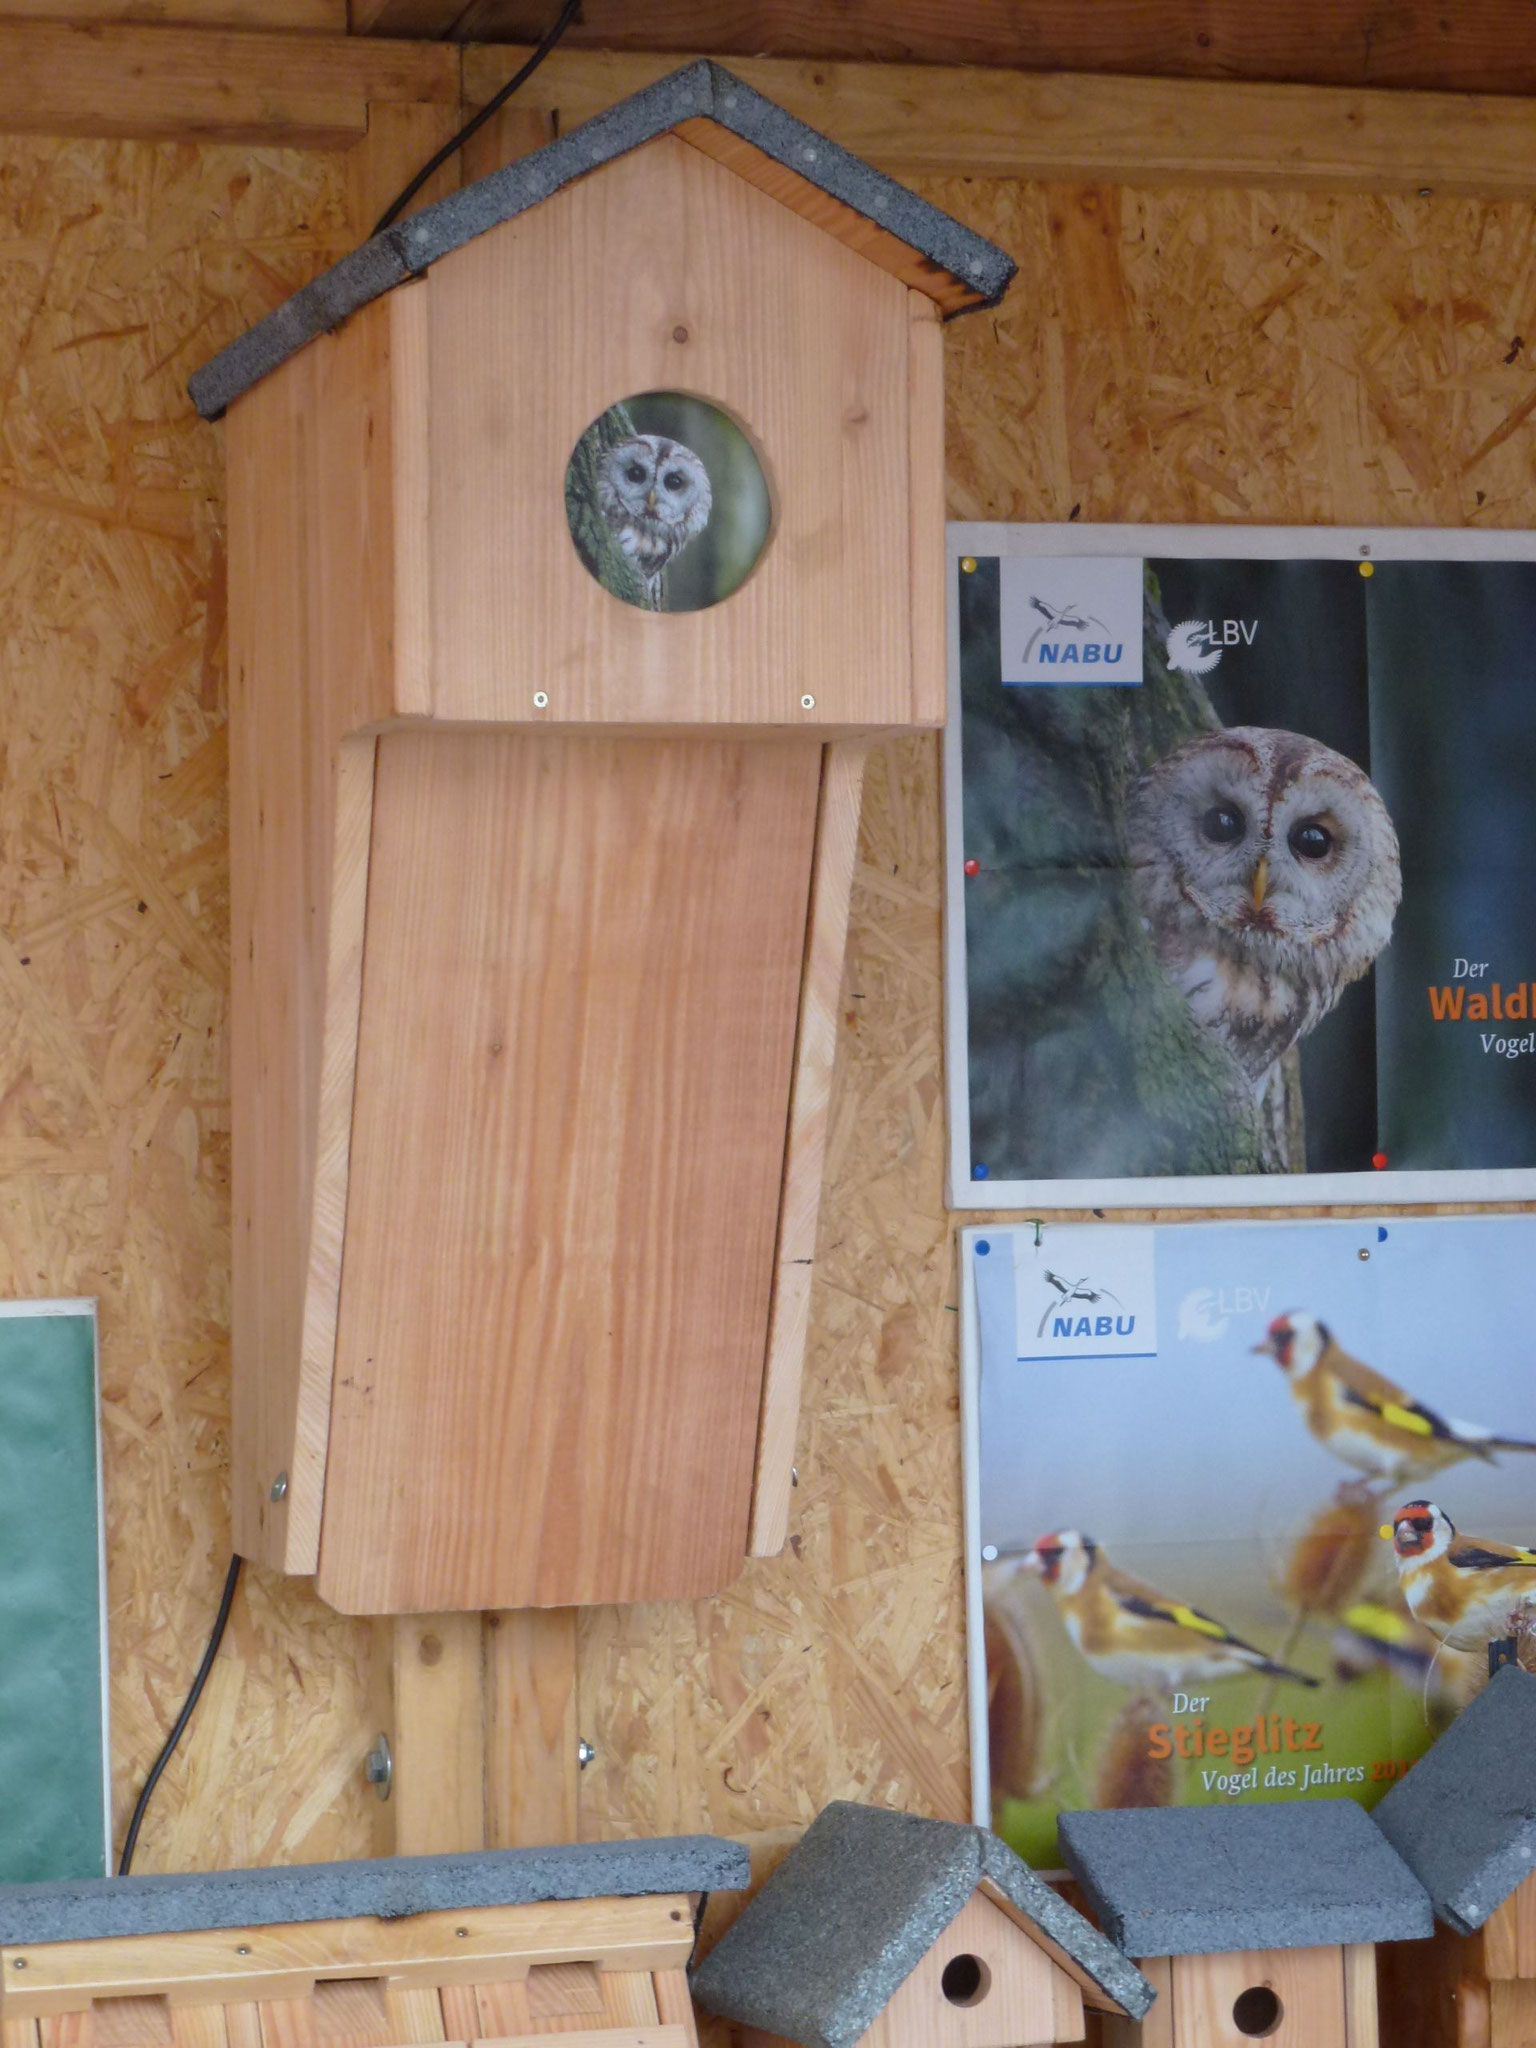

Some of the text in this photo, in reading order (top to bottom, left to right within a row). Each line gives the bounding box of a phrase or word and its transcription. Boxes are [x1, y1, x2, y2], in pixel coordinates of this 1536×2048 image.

[1208, 619, 1259, 646] LBV
[1038, 643, 1123, 664] NABU
[1453, 958, 1490, 978] Der
[1428, 982, 1536, 1021] Wald
[1480, 1032, 1536, 1059] Vogel
[1219, 1286, 1272, 1314] LBV
[1052, 1315, 1136, 1338] NABU
[1172, 1692, 1210, 1714] Der
[1147, 1714, 1323, 1766] Stieglitz
[1201, 1767, 1258, 1796] Vogel
[1264, 1766, 1297, 1787] des
[1300, 1762, 1365, 1792] Jahres
